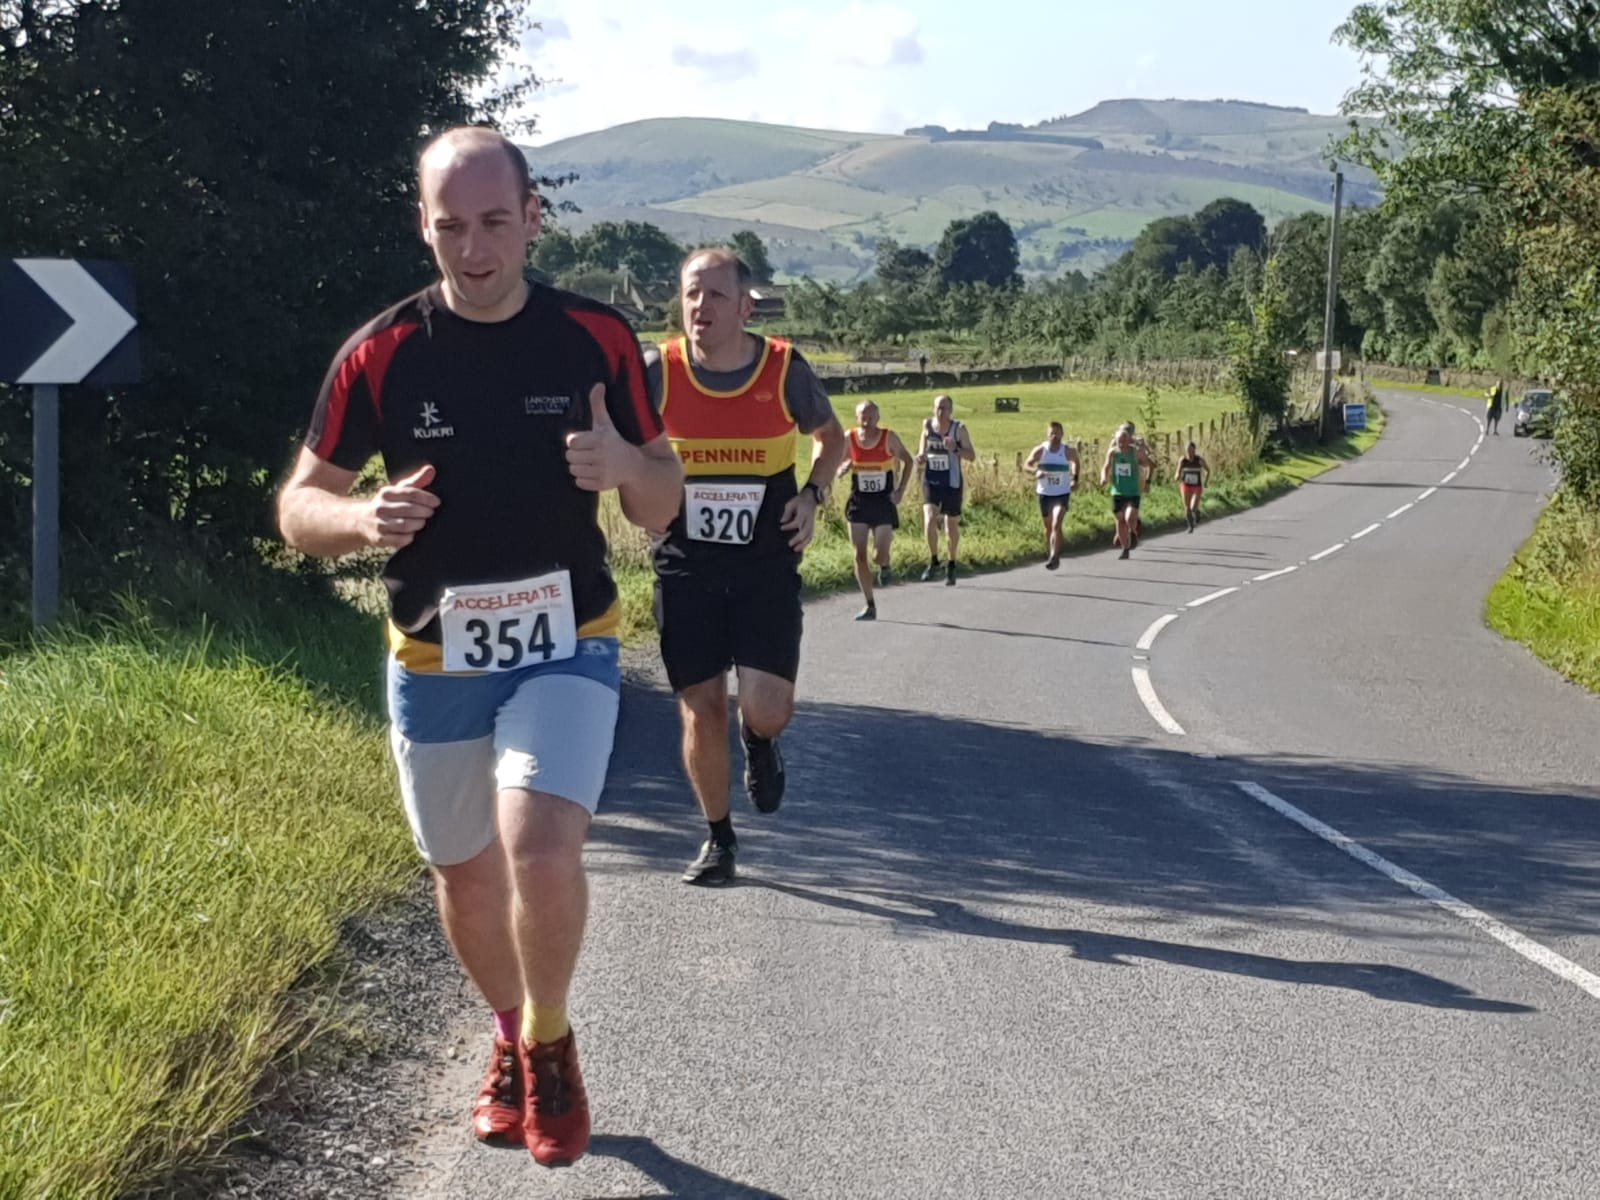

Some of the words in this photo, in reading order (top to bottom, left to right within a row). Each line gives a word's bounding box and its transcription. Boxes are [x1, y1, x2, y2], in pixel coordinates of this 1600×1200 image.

[413, 426, 455, 439] KUKRI
[679, 448, 767, 464] PENNINE
[693, 491, 761, 501] ACCELERATE
[700, 506, 753, 541] 320
[453, 584, 562, 610] ACCELERATE
[464, 612, 556, 669] 354
